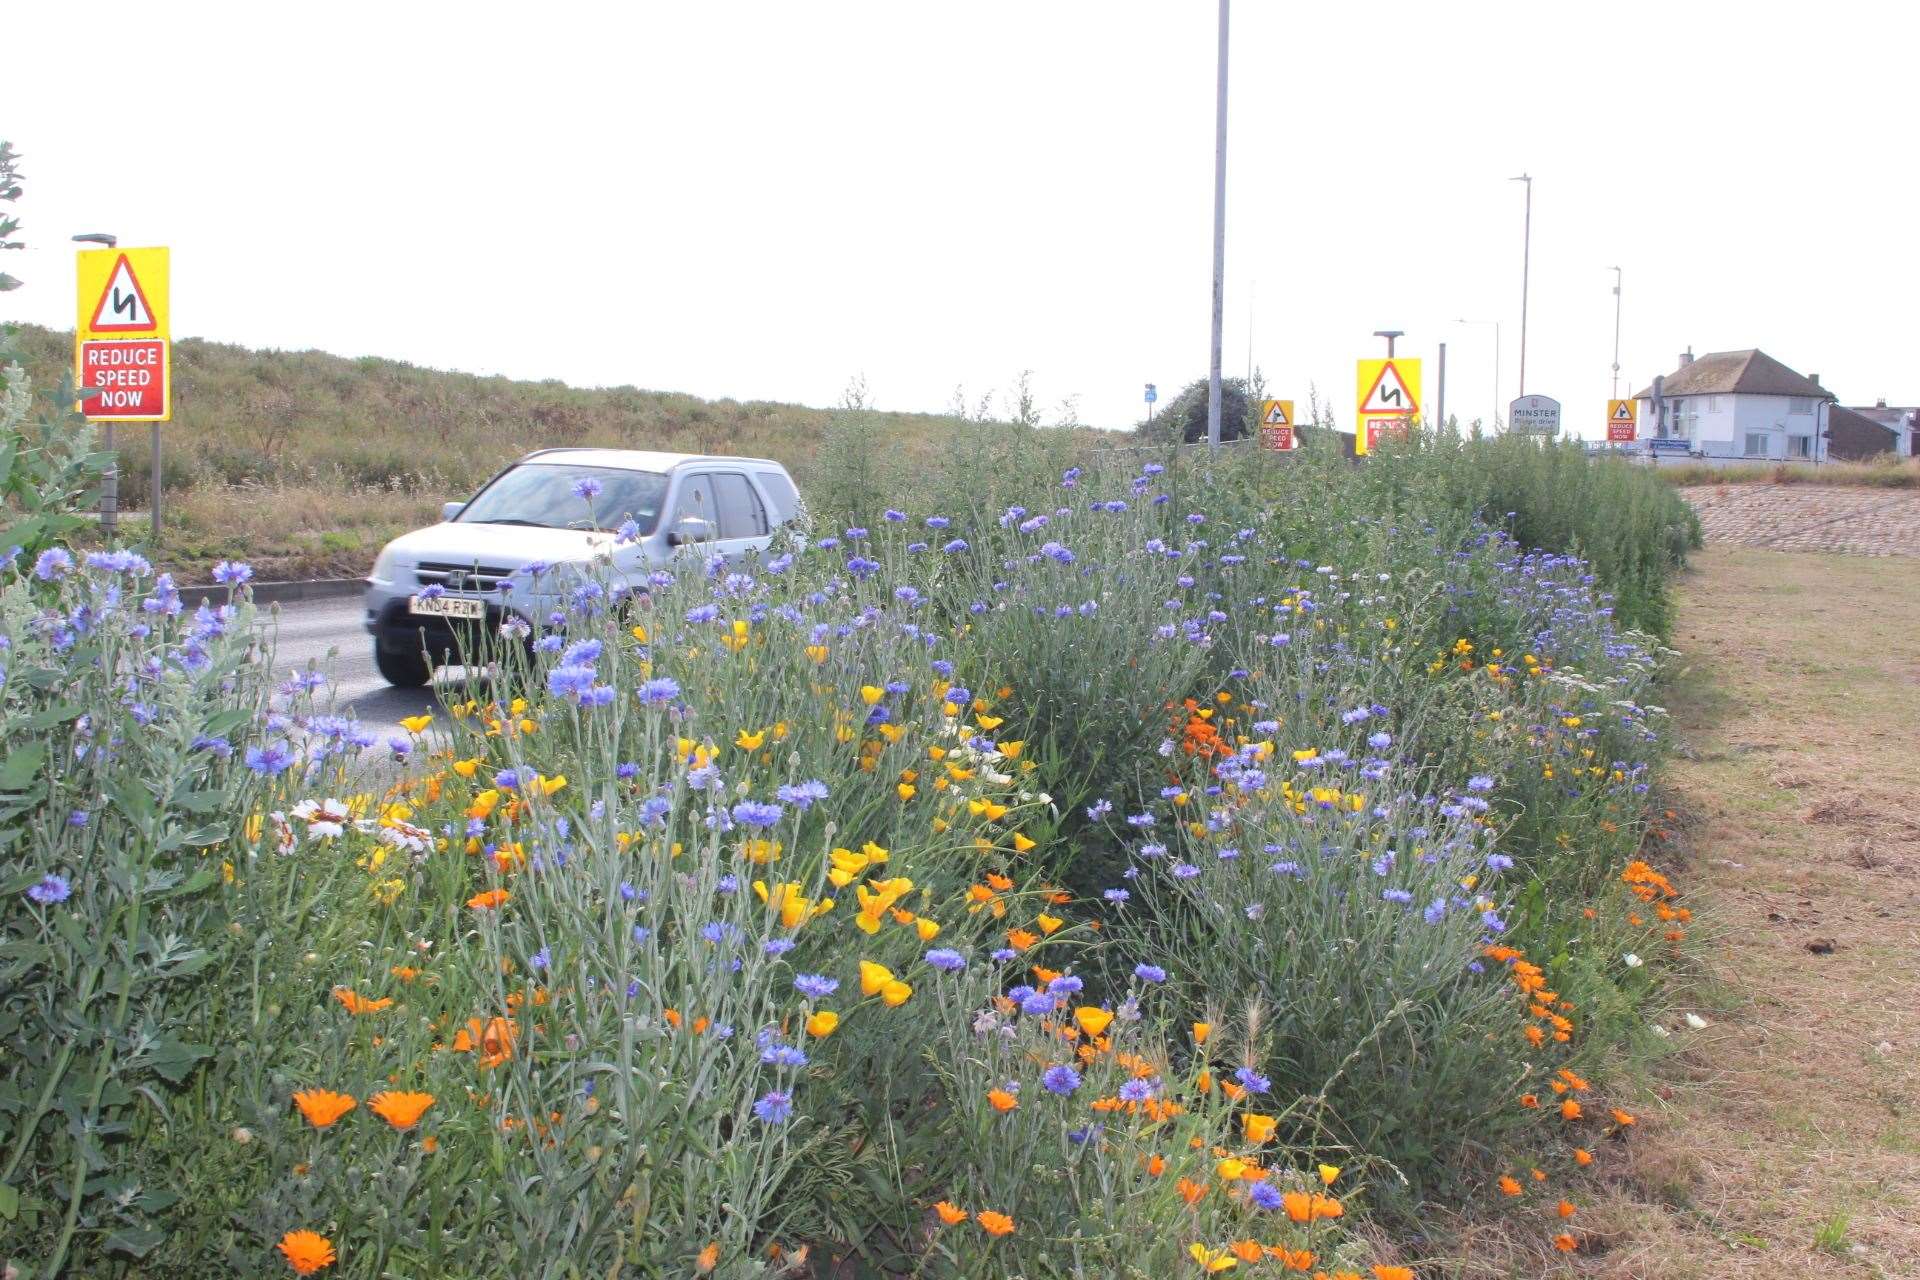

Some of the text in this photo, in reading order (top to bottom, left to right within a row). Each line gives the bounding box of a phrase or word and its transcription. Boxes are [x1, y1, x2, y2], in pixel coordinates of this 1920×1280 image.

[88, 348, 157, 365] REDUCE
[95, 369, 151, 386] SPEED
[101, 390, 142, 407] NOW
[1514, 409, 1557, 417] MINSTER
